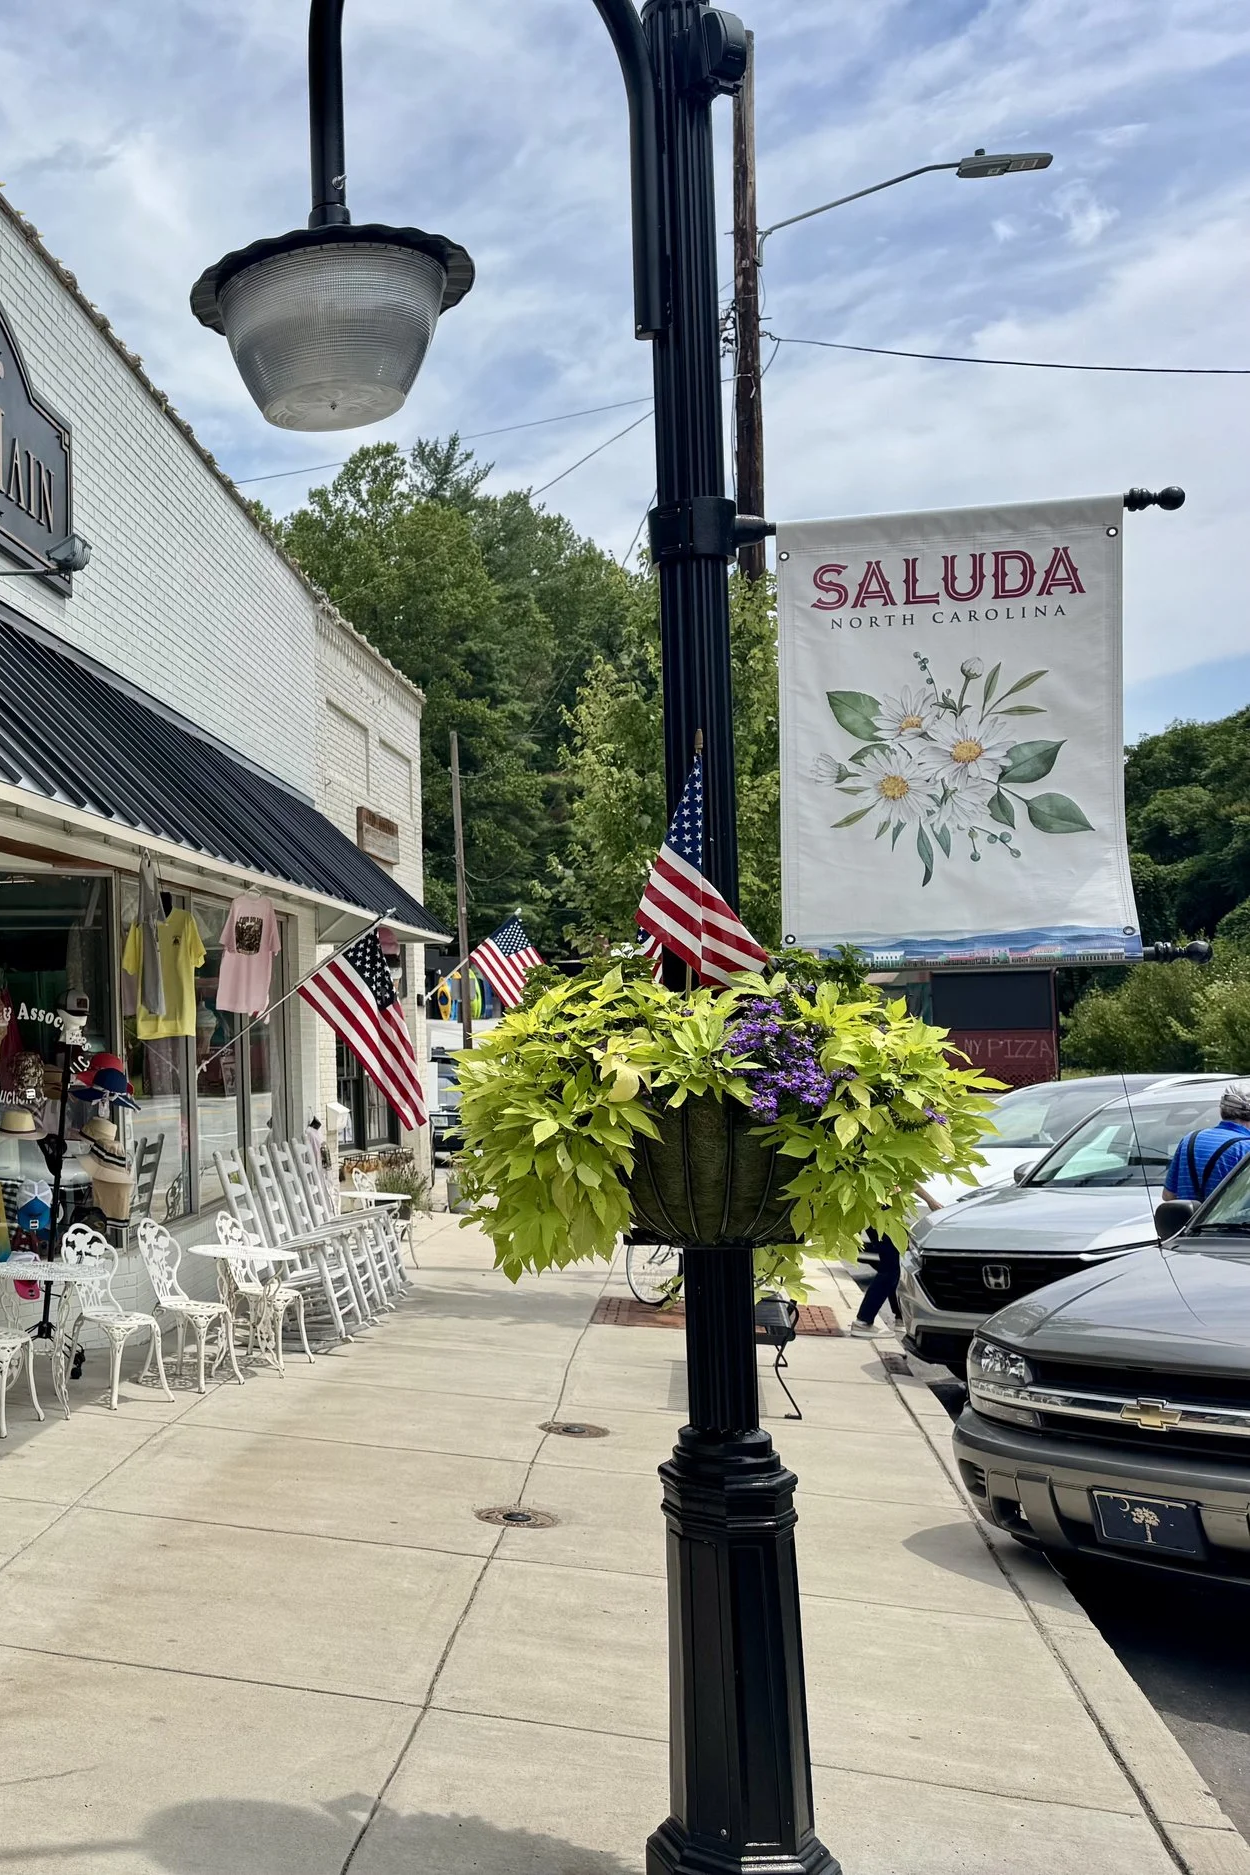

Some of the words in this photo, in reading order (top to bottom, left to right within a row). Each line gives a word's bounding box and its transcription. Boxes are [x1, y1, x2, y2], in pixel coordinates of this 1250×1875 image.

[810, 545, 1086, 611] SALUDA
[831, 613, 915, 630] NORTH
[932, 604, 1066, 625] CAROLINA
[3, 1006, 12, 1022] &
[964, 1038, 982, 1055] NY
[988, 1038, 1053, 1058] PIZZA
